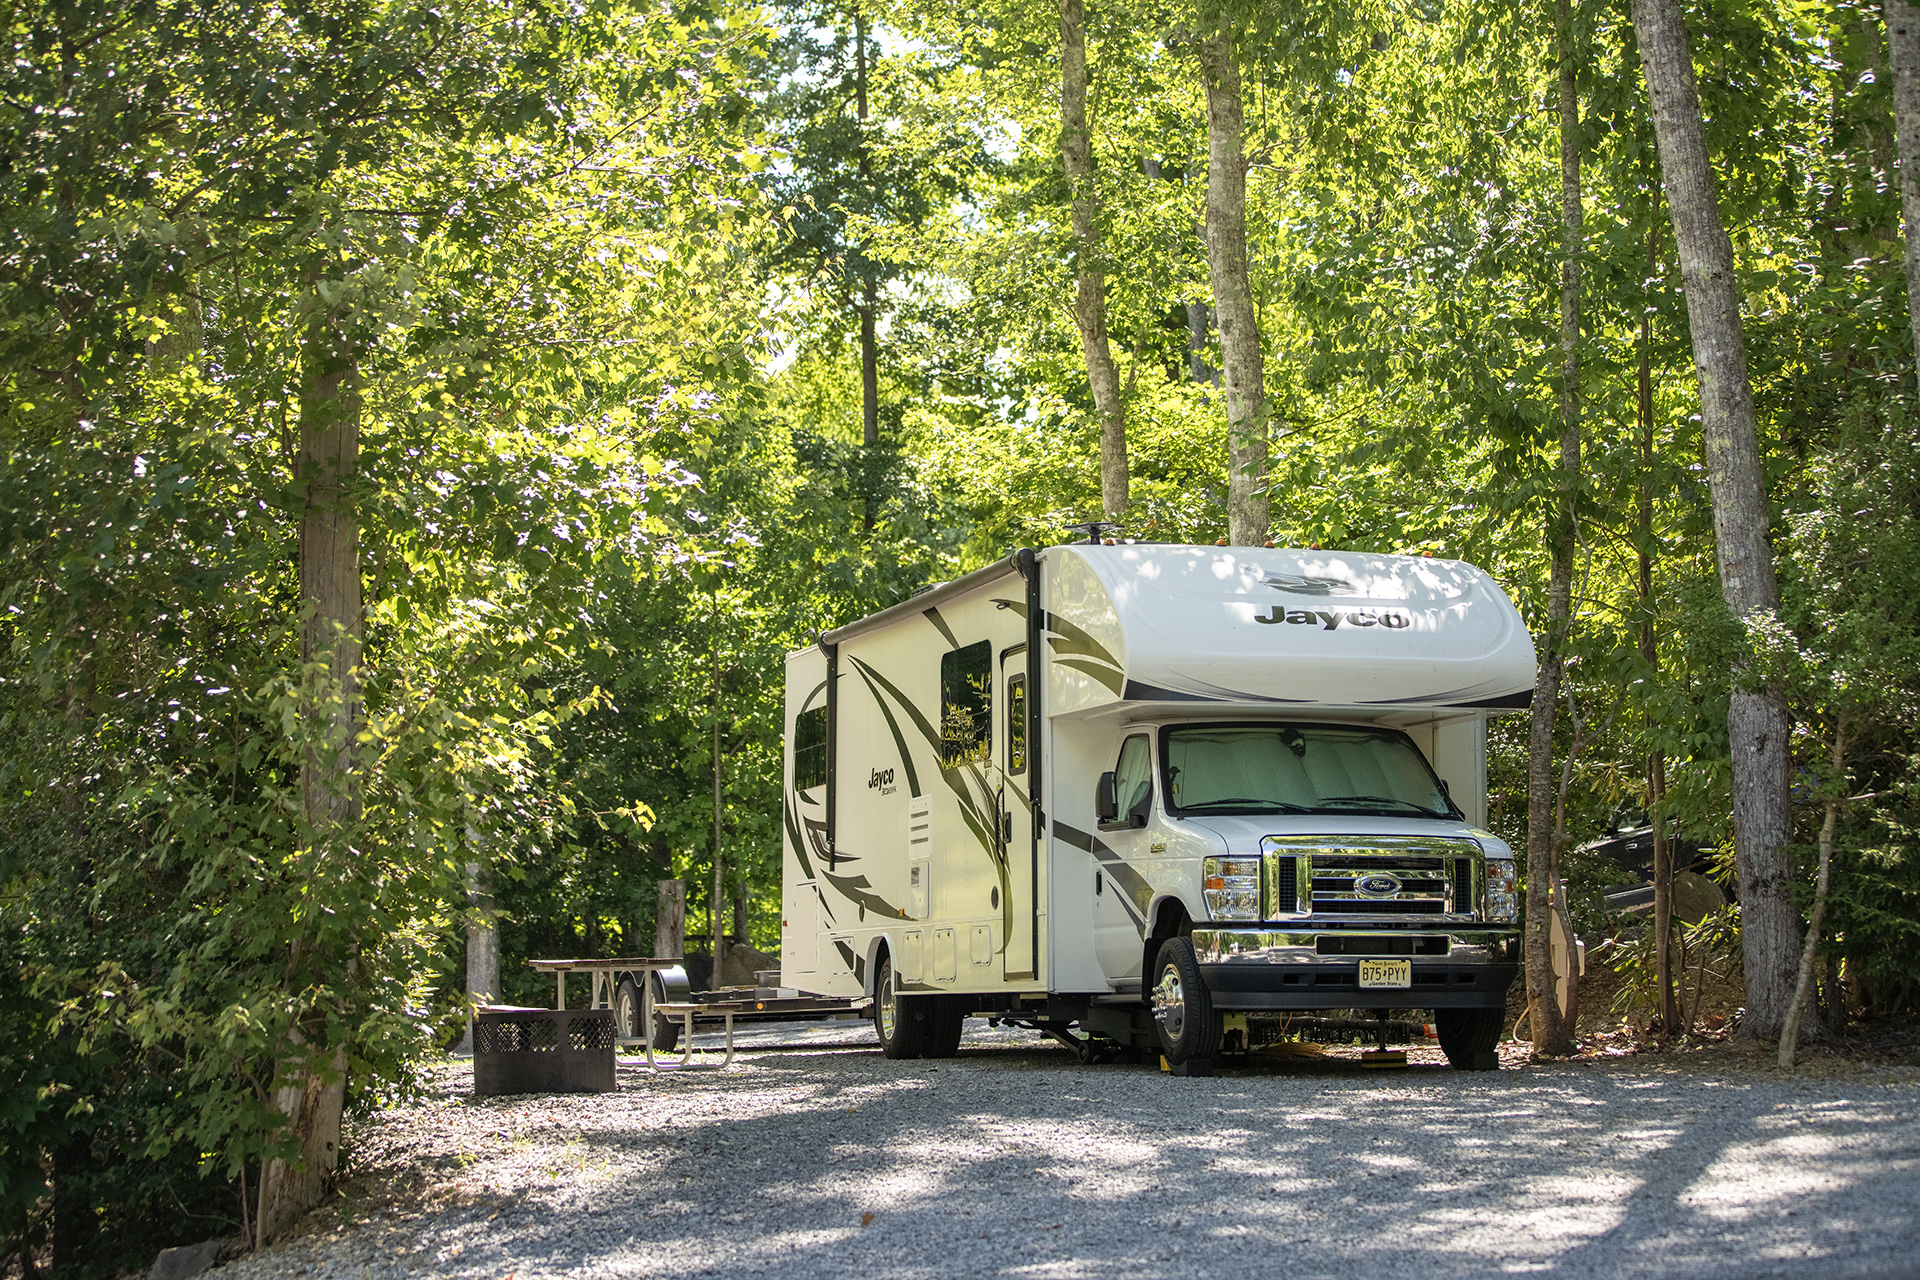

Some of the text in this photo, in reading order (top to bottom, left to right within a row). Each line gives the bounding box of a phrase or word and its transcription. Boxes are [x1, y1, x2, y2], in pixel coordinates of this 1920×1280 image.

[1254, 605, 1410, 631] Jayco
[868, 767, 894, 791] Jayco
[1370, 879, 1391, 889] Ford
[1362, 967, 1407, 981] B75 PYY
